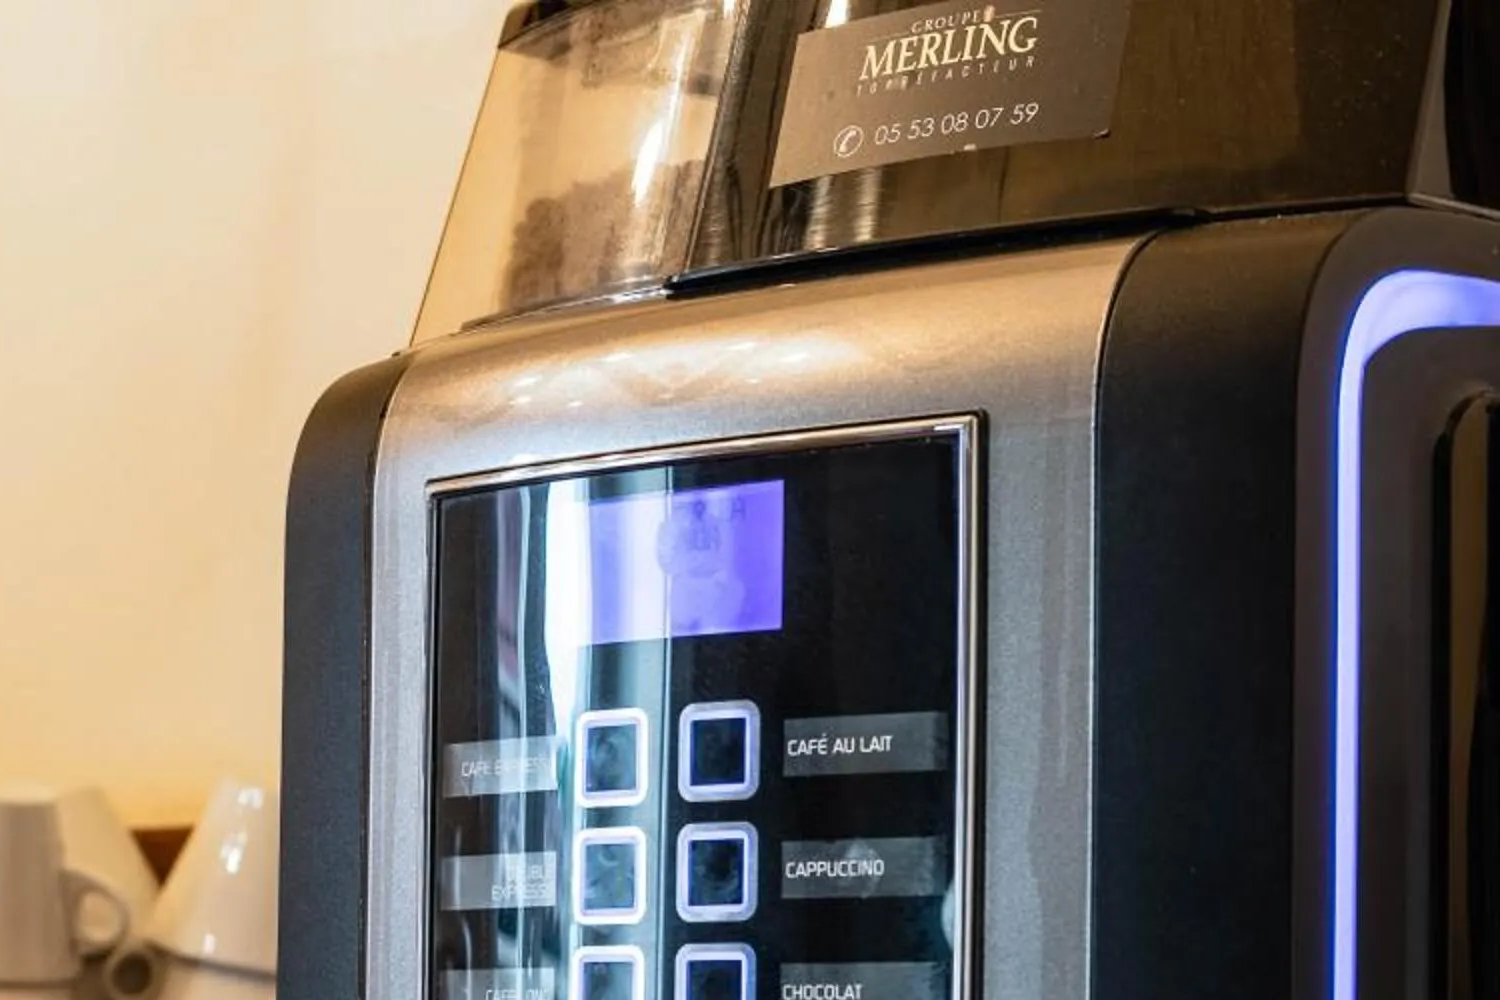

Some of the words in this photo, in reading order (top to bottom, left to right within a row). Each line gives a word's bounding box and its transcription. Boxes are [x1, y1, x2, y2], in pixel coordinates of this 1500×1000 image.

[911, 10, 980, 34] GROUPE
[859, 17, 1038, 81] MERLING
[874, 123, 901, 145] 05
[907, 112, 935, 140] 53
[941, 111, 969, 135] 08
[975, 107, 1004, 129] 07
[1010, 102, 1039, 125] 59
[787, 731, 829, 757] CAFÉ
[832, 736, 855, 754] AU
[859, 735, 894, 753] LAIT
[785, 859, 885, 879] CAPPUCCINO
[782, 983, 863, 1000] CHOCOLAT
